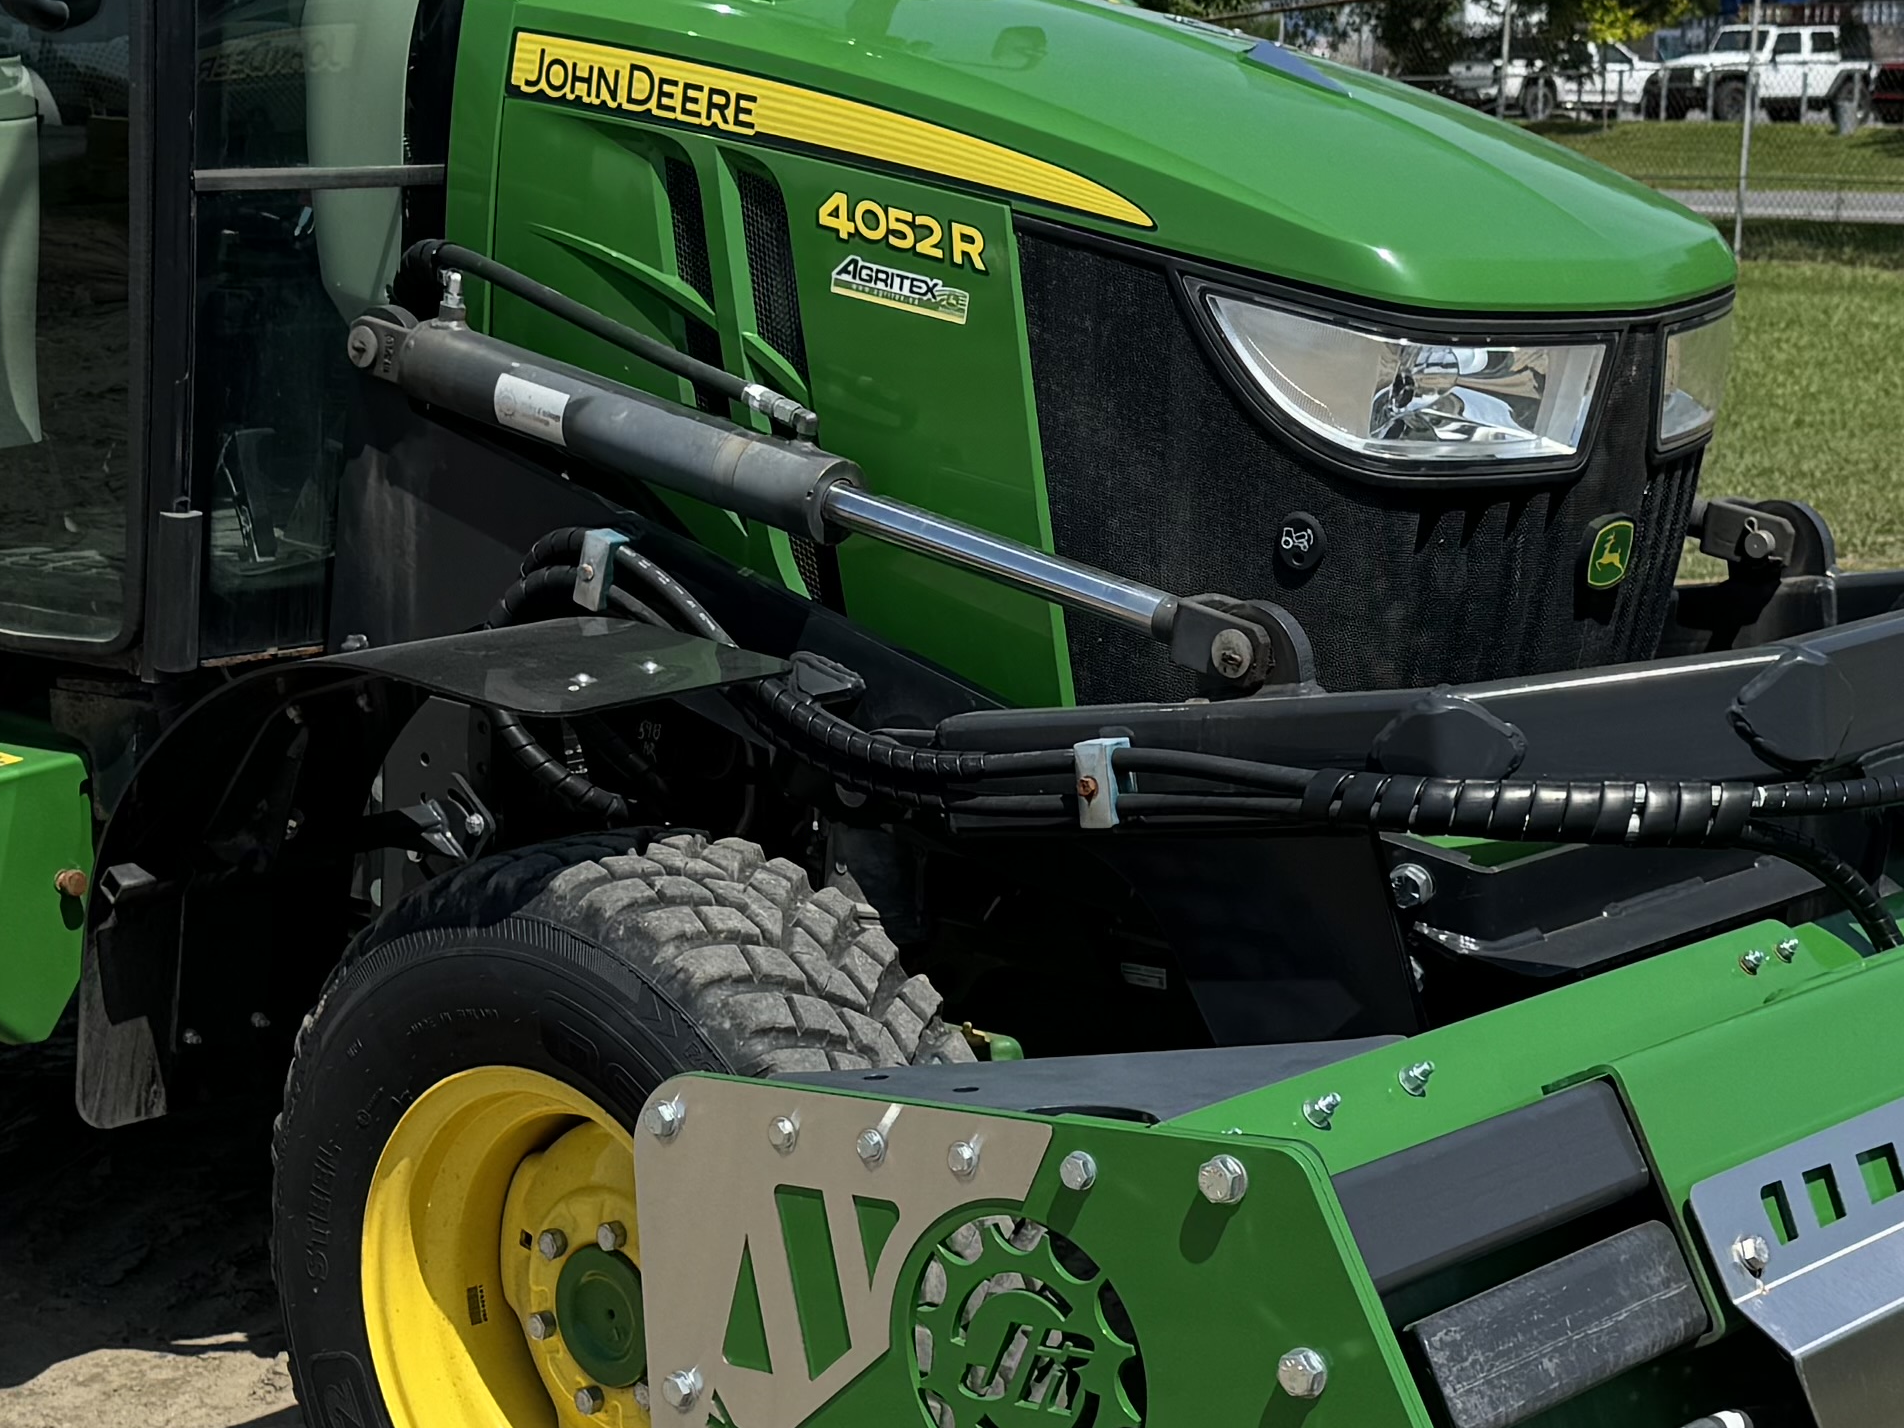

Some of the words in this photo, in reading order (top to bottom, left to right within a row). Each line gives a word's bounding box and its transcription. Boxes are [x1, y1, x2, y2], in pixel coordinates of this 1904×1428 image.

[524, 48, 620, 102] JOHN
[626, 63, 758, 130] DEERE
[819, 191, 943, 259] 4052
[951, 221, 986, 271] R
[836, 257, 939, 300] AGRITEX
